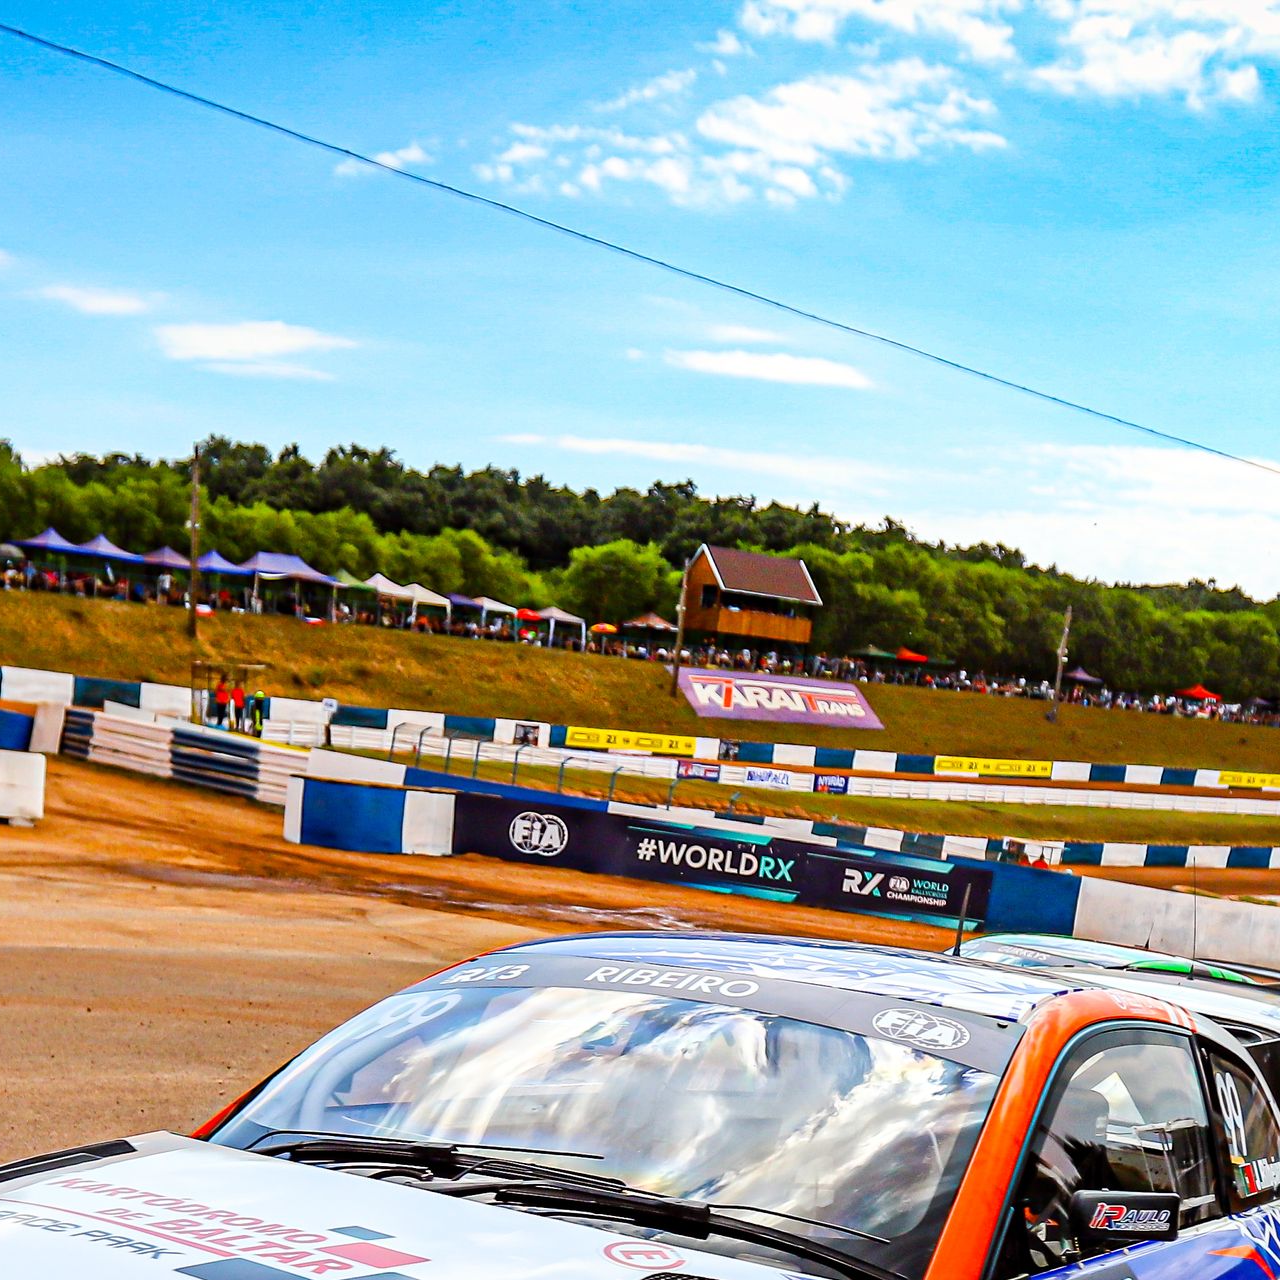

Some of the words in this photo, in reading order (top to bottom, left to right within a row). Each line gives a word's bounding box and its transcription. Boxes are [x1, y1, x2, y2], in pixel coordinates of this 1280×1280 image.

[637, 836, 796, 883] #WORLDRX
[842, 867, 886, 897] RX
[913, 878, 950, 893] WORLD
[886, 890, 948, 908] CHAMPIONSHIP
[584, 965, 760, 998] RIBEIRO
[878, 1010, 958, 1047] FIA
[49, 1177, 328, 1244] KARTÓDROMO
[70, 1229, 186, 1260] PARK
[96, 1207, 154, 1221] DE
[146, 1218, 354, 1275] BALTAR
